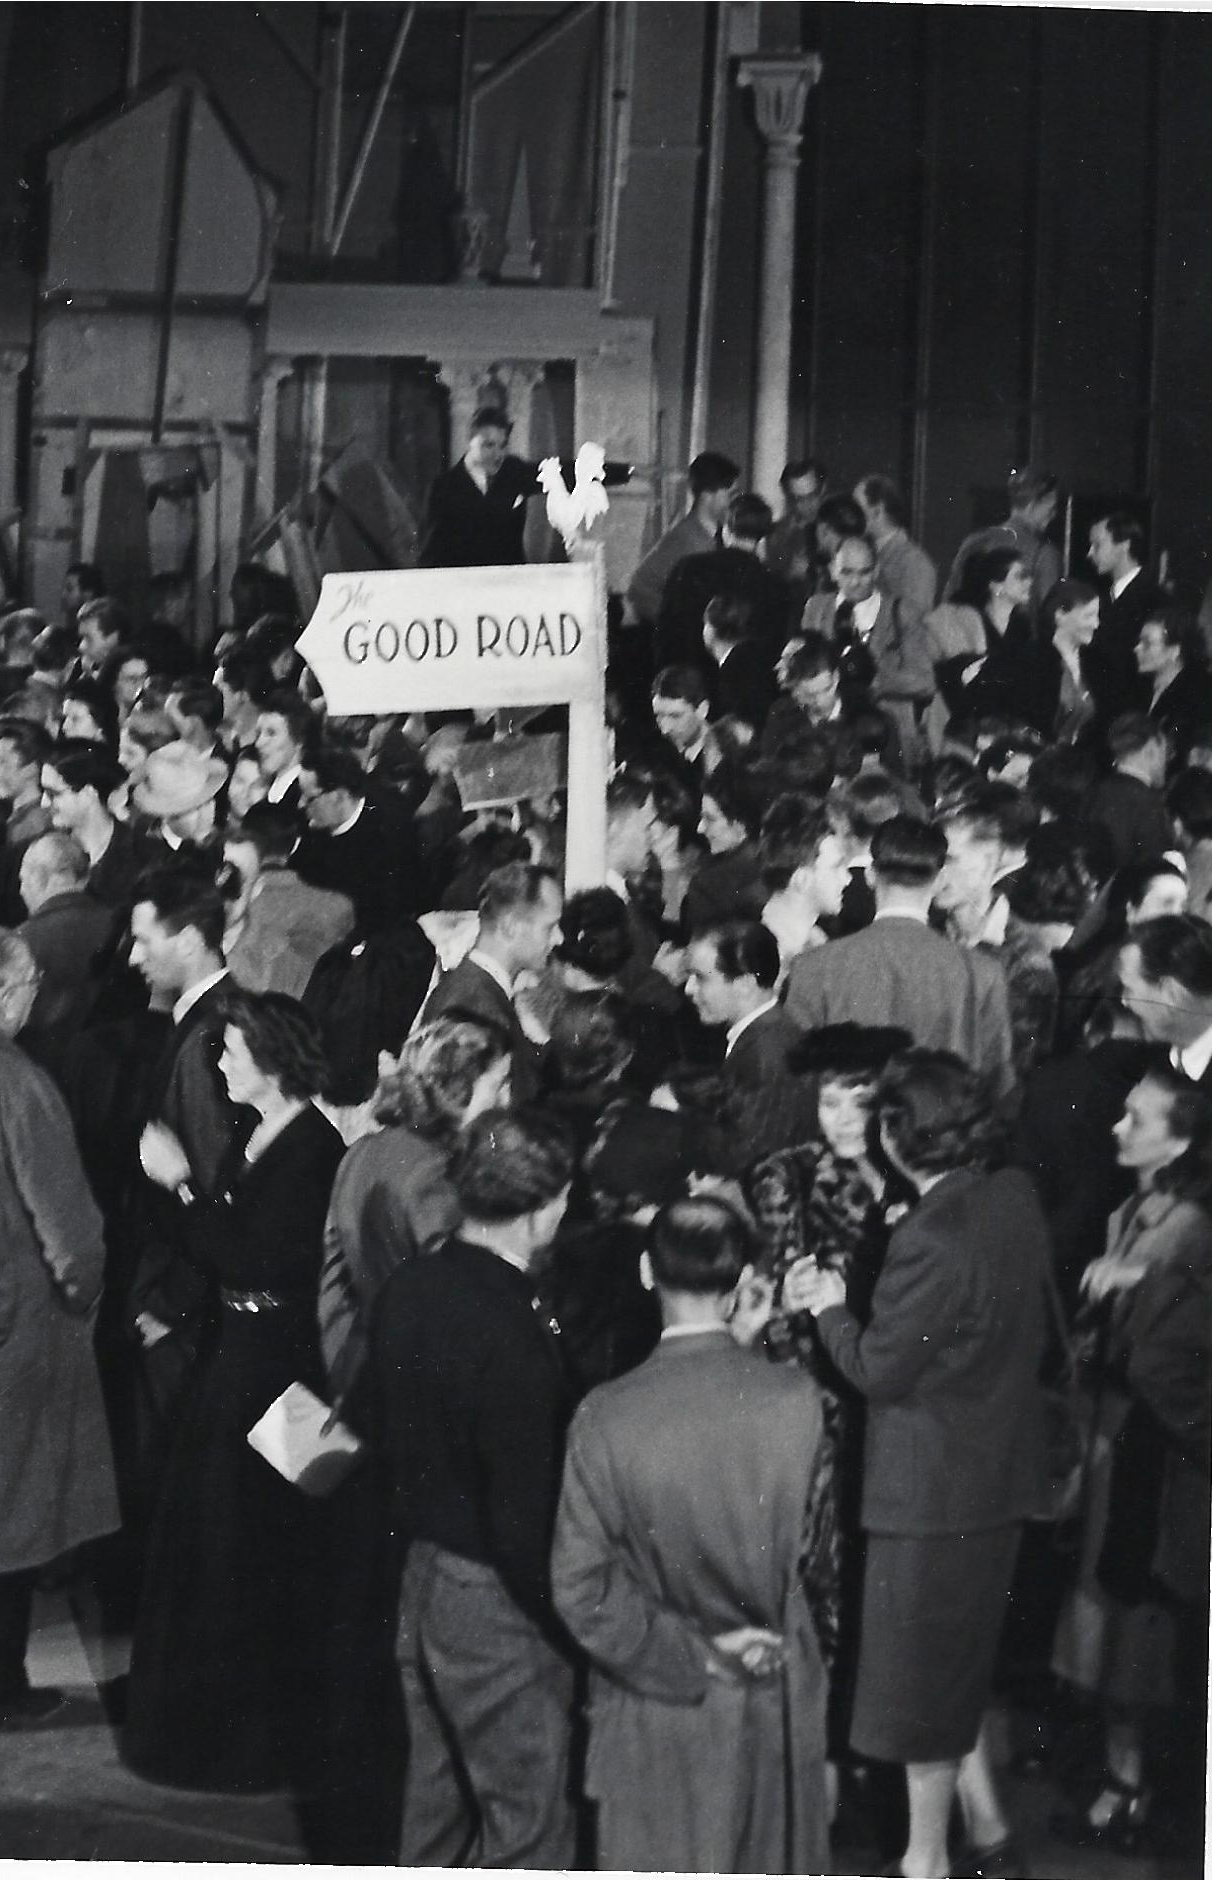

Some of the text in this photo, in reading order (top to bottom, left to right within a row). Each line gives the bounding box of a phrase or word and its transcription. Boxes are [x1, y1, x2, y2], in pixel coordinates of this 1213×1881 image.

[329, 579, 374, 623] The
[343, 612, 582, 664] GOOD ROAD
